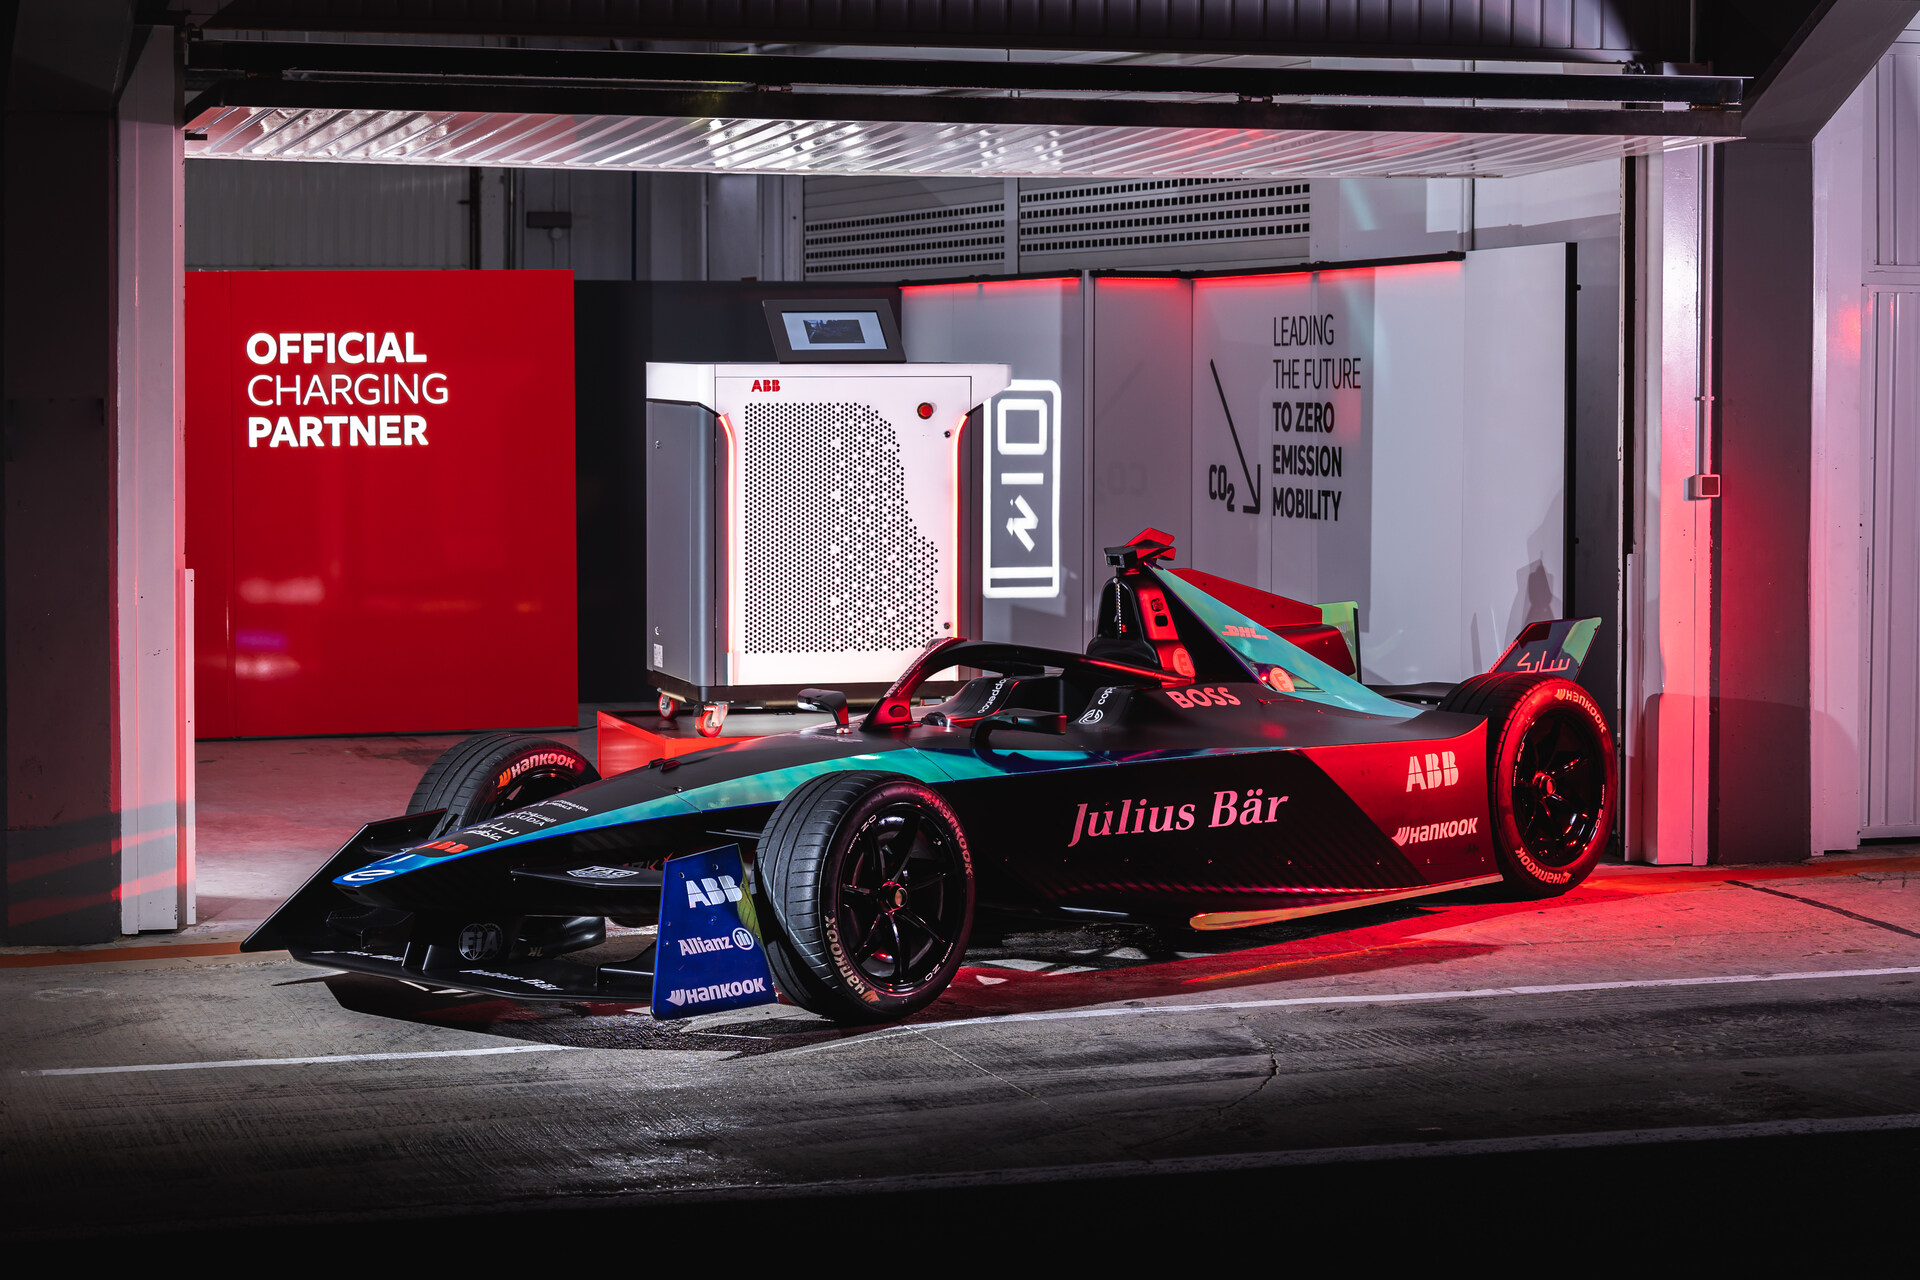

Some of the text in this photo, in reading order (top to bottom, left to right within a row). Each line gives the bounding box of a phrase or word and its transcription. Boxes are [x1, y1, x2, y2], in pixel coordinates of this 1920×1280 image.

[1273, 314, 1335, 347] LEADING
[246, 331, 427, 365] OFFICIAL
[247, 372, 449, 406] CHARGING
[751, 379, 781, 393] ABB
[1272, 357, 1361, 390] THE FUTURE
[247, 414, 429, 448] PARTNER
[1272, 402, 1335, 433] TO ZERO
[1272, 444, 1342, 477] EMISSION
[1272, 486, 1342, 521] MOBILITY
[1221, 625, 1269, 640] DHL
[1165, 686, 1241, 709] BOSS
[510, 753, 576, 779] Hankook
[1405, 751, 1459, 792] ABB
[1068, 788, 1289, 847] Julius Bär
[1408, 817, 1478, 845] Hankook
[685, 875, 743, 909] ABB
[678, 936, 733, 957] Allianz
[686, 977, 767, 1004] Hankook
